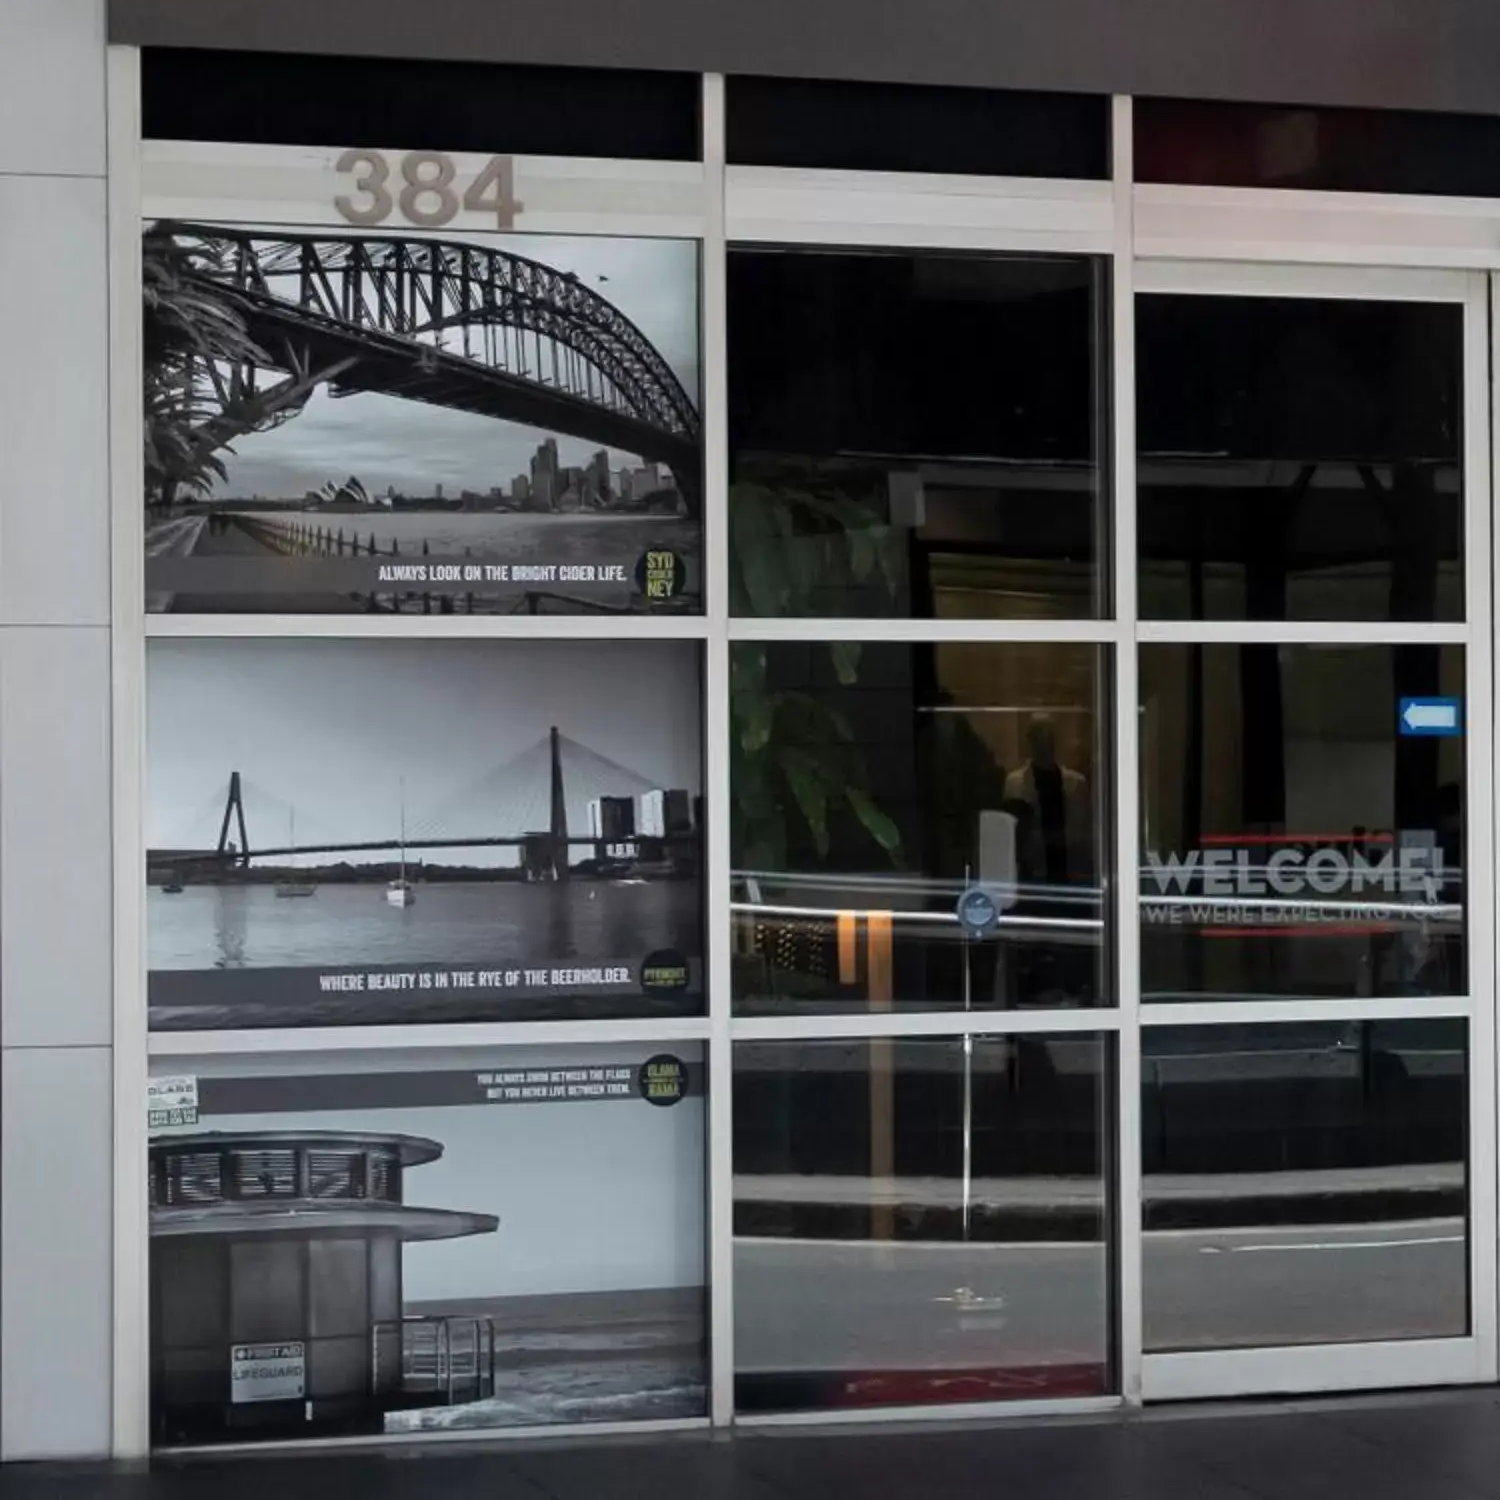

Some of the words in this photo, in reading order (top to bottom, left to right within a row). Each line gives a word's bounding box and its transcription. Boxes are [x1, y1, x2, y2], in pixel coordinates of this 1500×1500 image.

[334, 150, 525, 232] 384
[379, 565, 427, 581] ALWAYS
[429, 565, 461, 581] LOOK
[463, 565, 482, 581] ON
[484, 565, 509, 581] THE
[559, 565, 595, 581] CIDER
[1148, 847, 1444, 894] WELCOME!
[319, 974, 365, 992] WHERE
[367, 972, 416, 990] BEAUTY
[419, 972, 432, 989] IS
[435, 972, 448, 988] IN
[451, 971, 475, 988] THE
[479, 971, 502, 987] RYE
[505, 970, 521, 986] OF
[523, 969, 548, 986] THE
